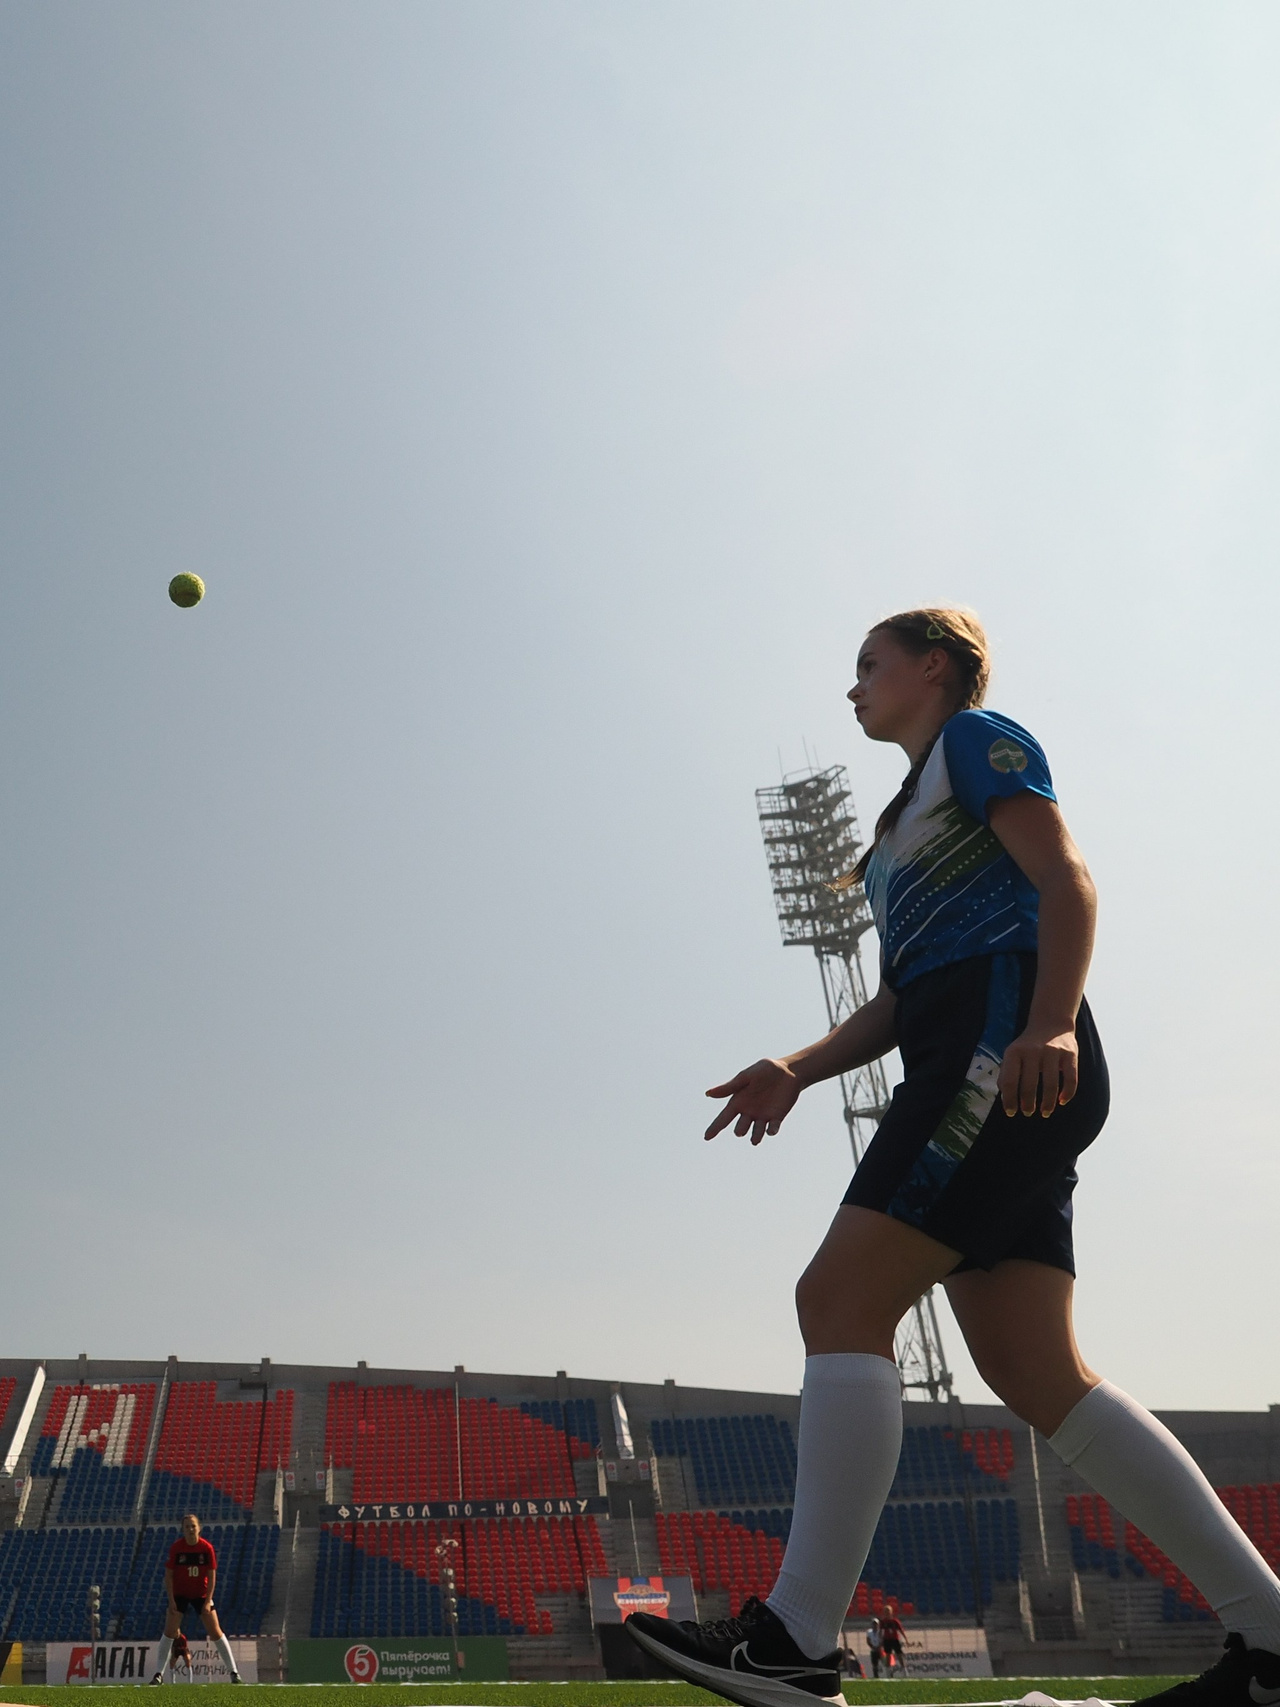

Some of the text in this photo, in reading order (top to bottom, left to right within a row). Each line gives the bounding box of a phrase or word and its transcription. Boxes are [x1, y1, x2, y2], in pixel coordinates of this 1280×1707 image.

[338, 1500, 588, 1518] ФУТБОЛ ПО-НОВОМУ
[187, 1566, 199, 1577] 10
[95, 1646, 150, 1678] АГАТ
[380, 1650, 450, 1663] Пятёрочка
[381, 1665, 451, 1679] выручает!
